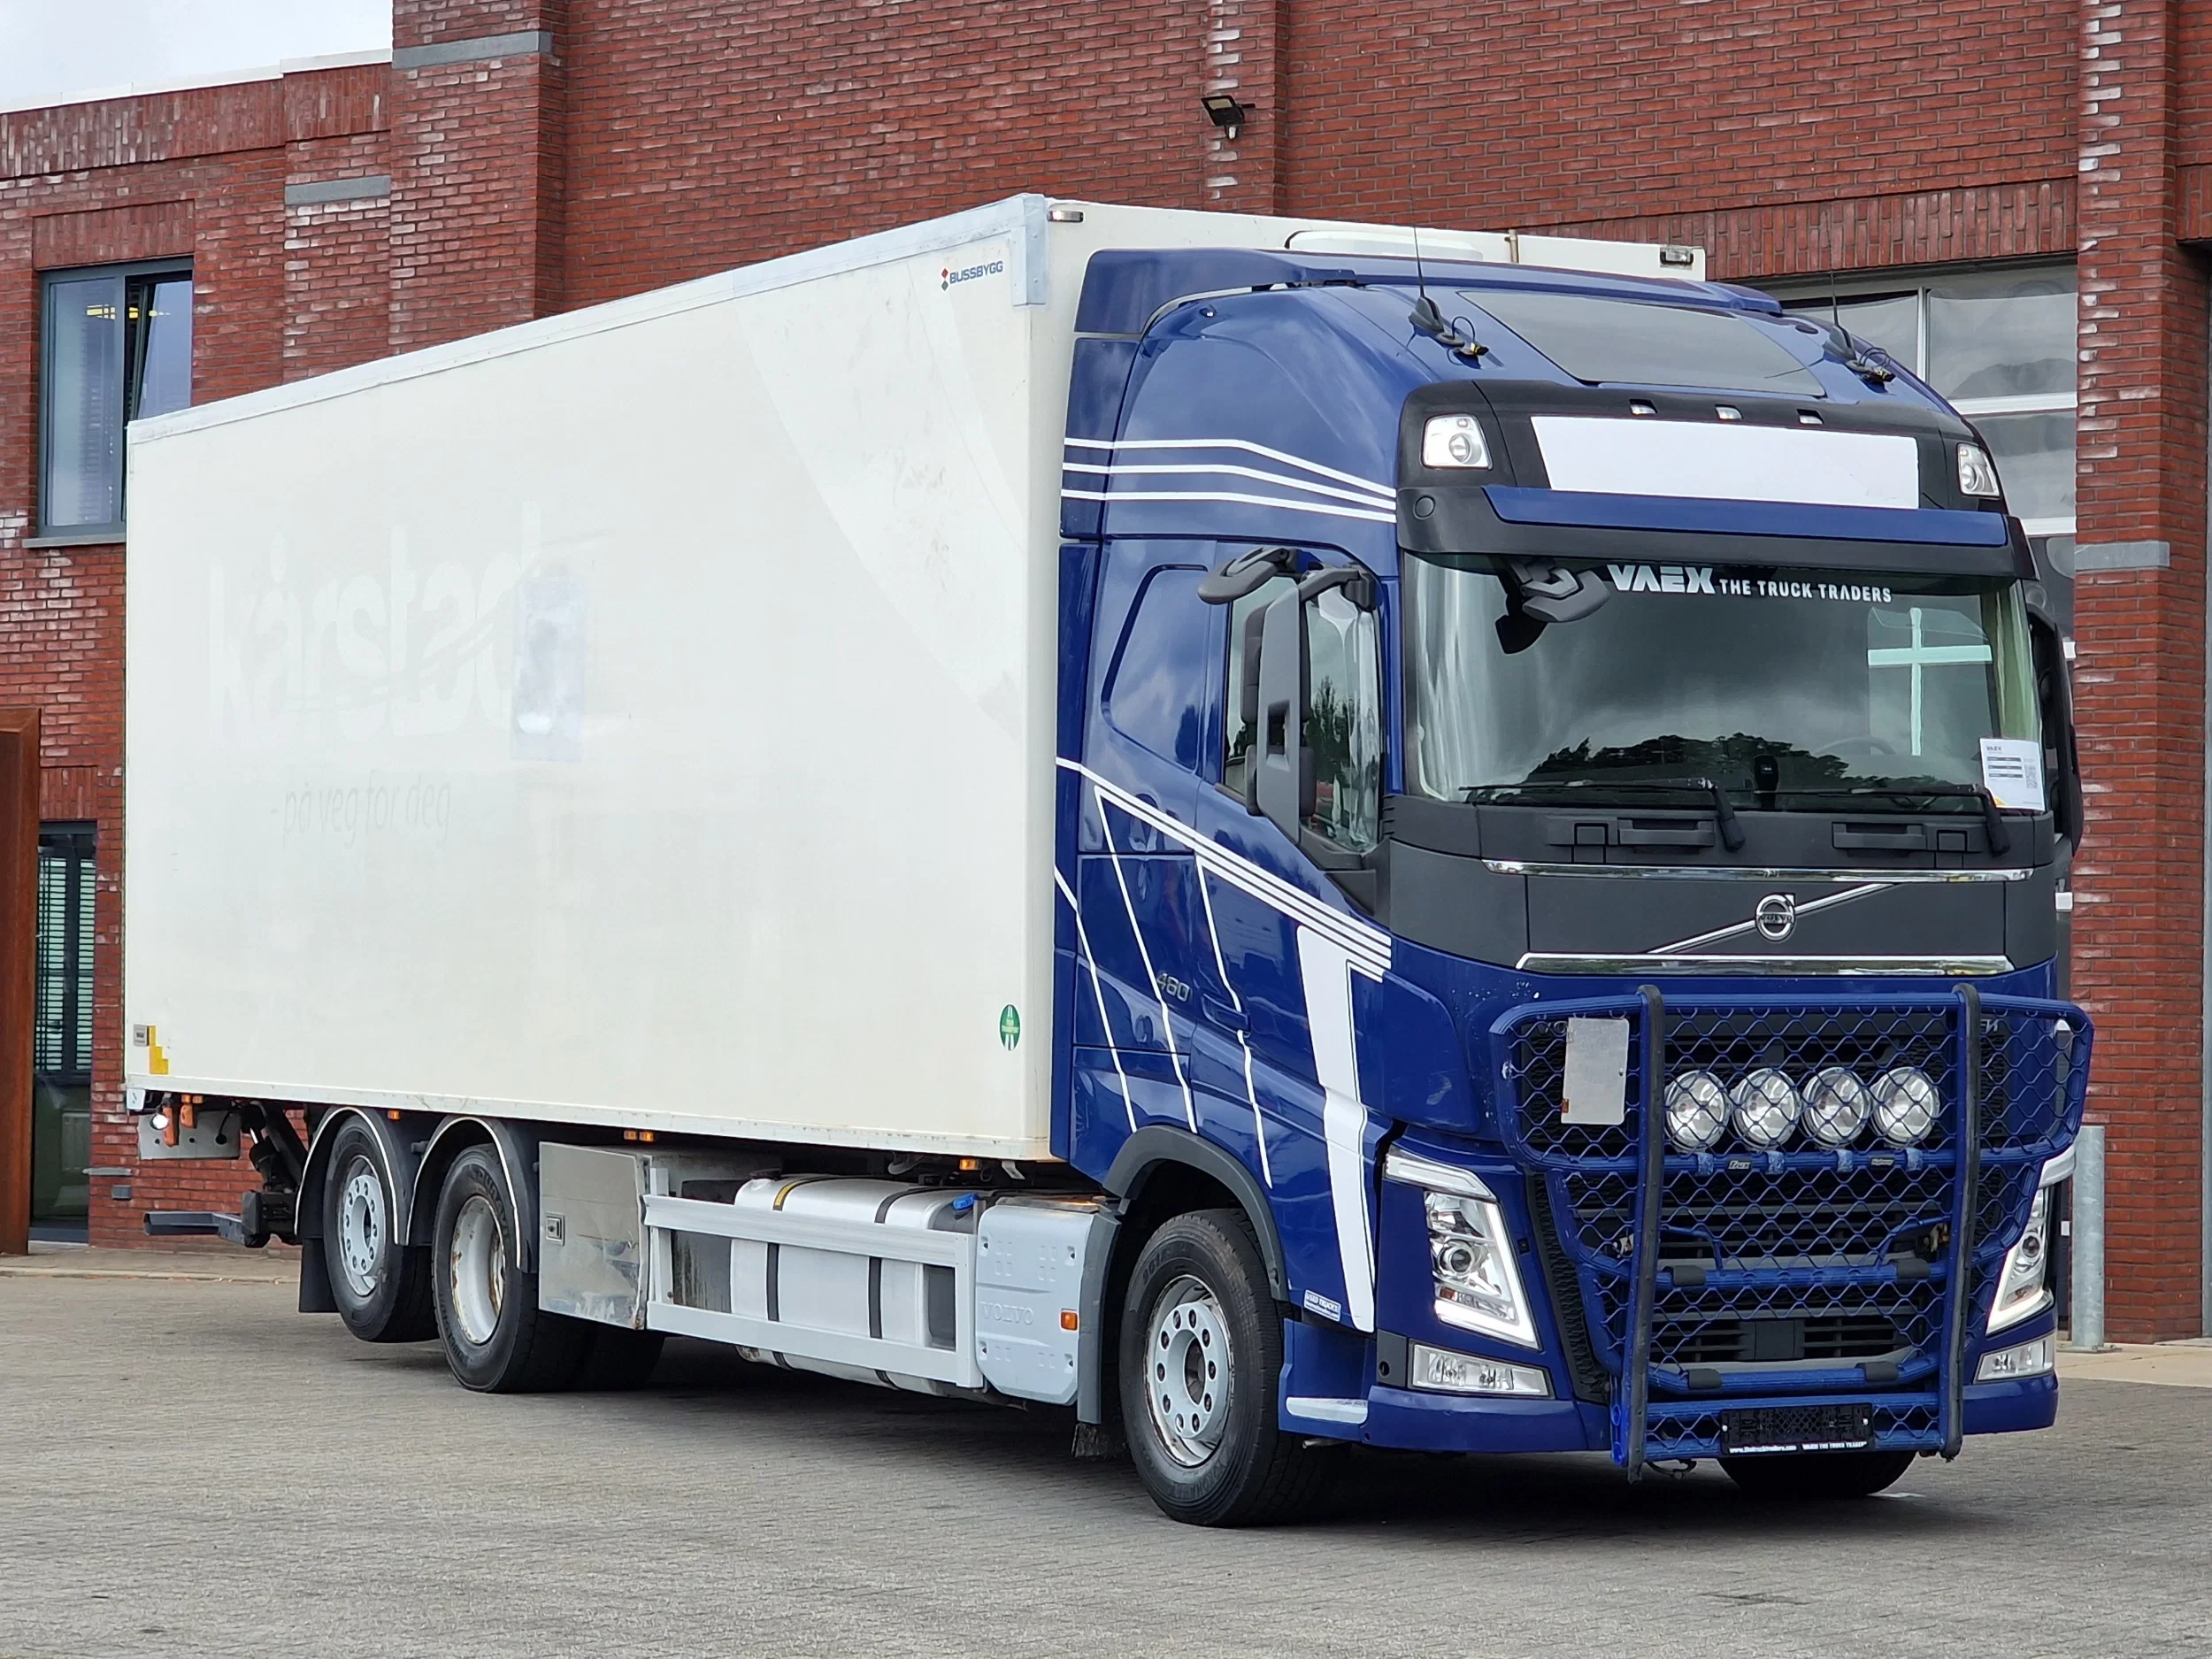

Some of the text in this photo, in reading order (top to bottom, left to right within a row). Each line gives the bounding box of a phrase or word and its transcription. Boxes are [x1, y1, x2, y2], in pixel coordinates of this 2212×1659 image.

[949, 260, 1003, 284] BUSSBYGG
[1608, 565, 1892, 603] VAEX THE TRUCK TRADERS
[979, 1302, 1034, 1326] VOLVO
